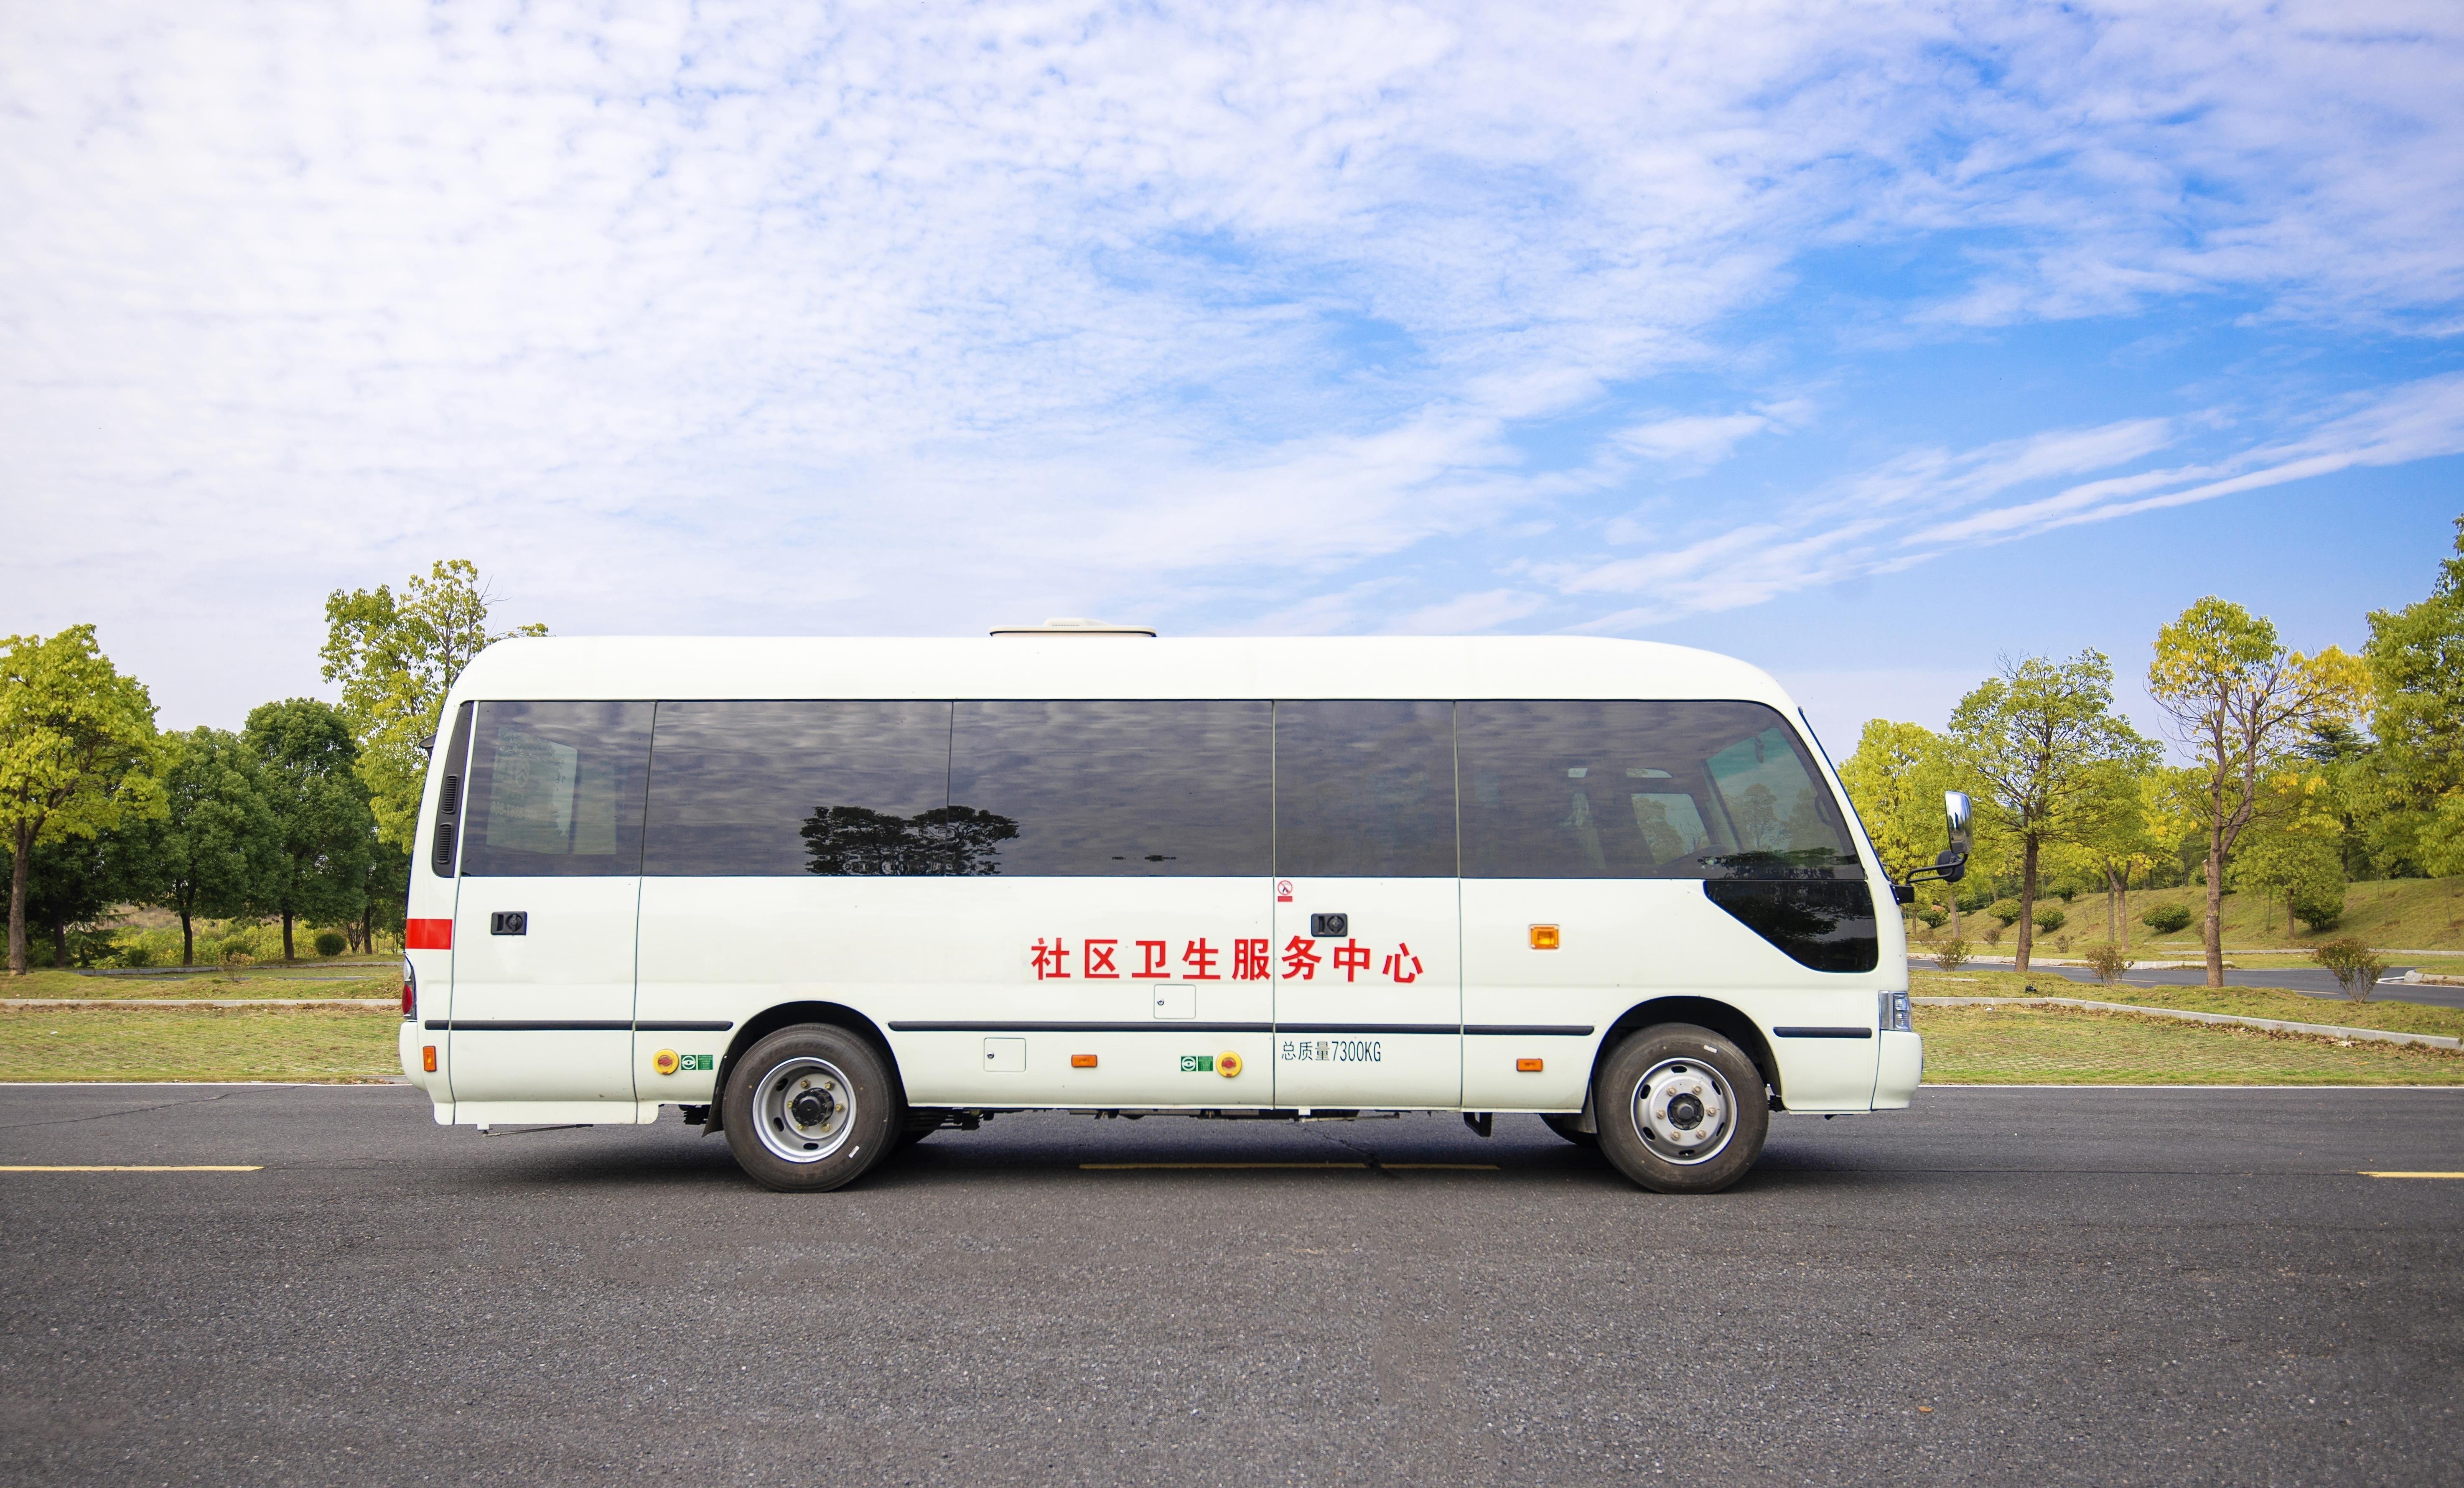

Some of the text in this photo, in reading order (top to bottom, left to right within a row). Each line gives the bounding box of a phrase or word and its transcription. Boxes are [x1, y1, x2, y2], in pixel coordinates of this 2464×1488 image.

[1031, 936, 1423, 983] 社区卫生服务中心
[1282, 1041, 1380, 1062] 总质量7300KG
